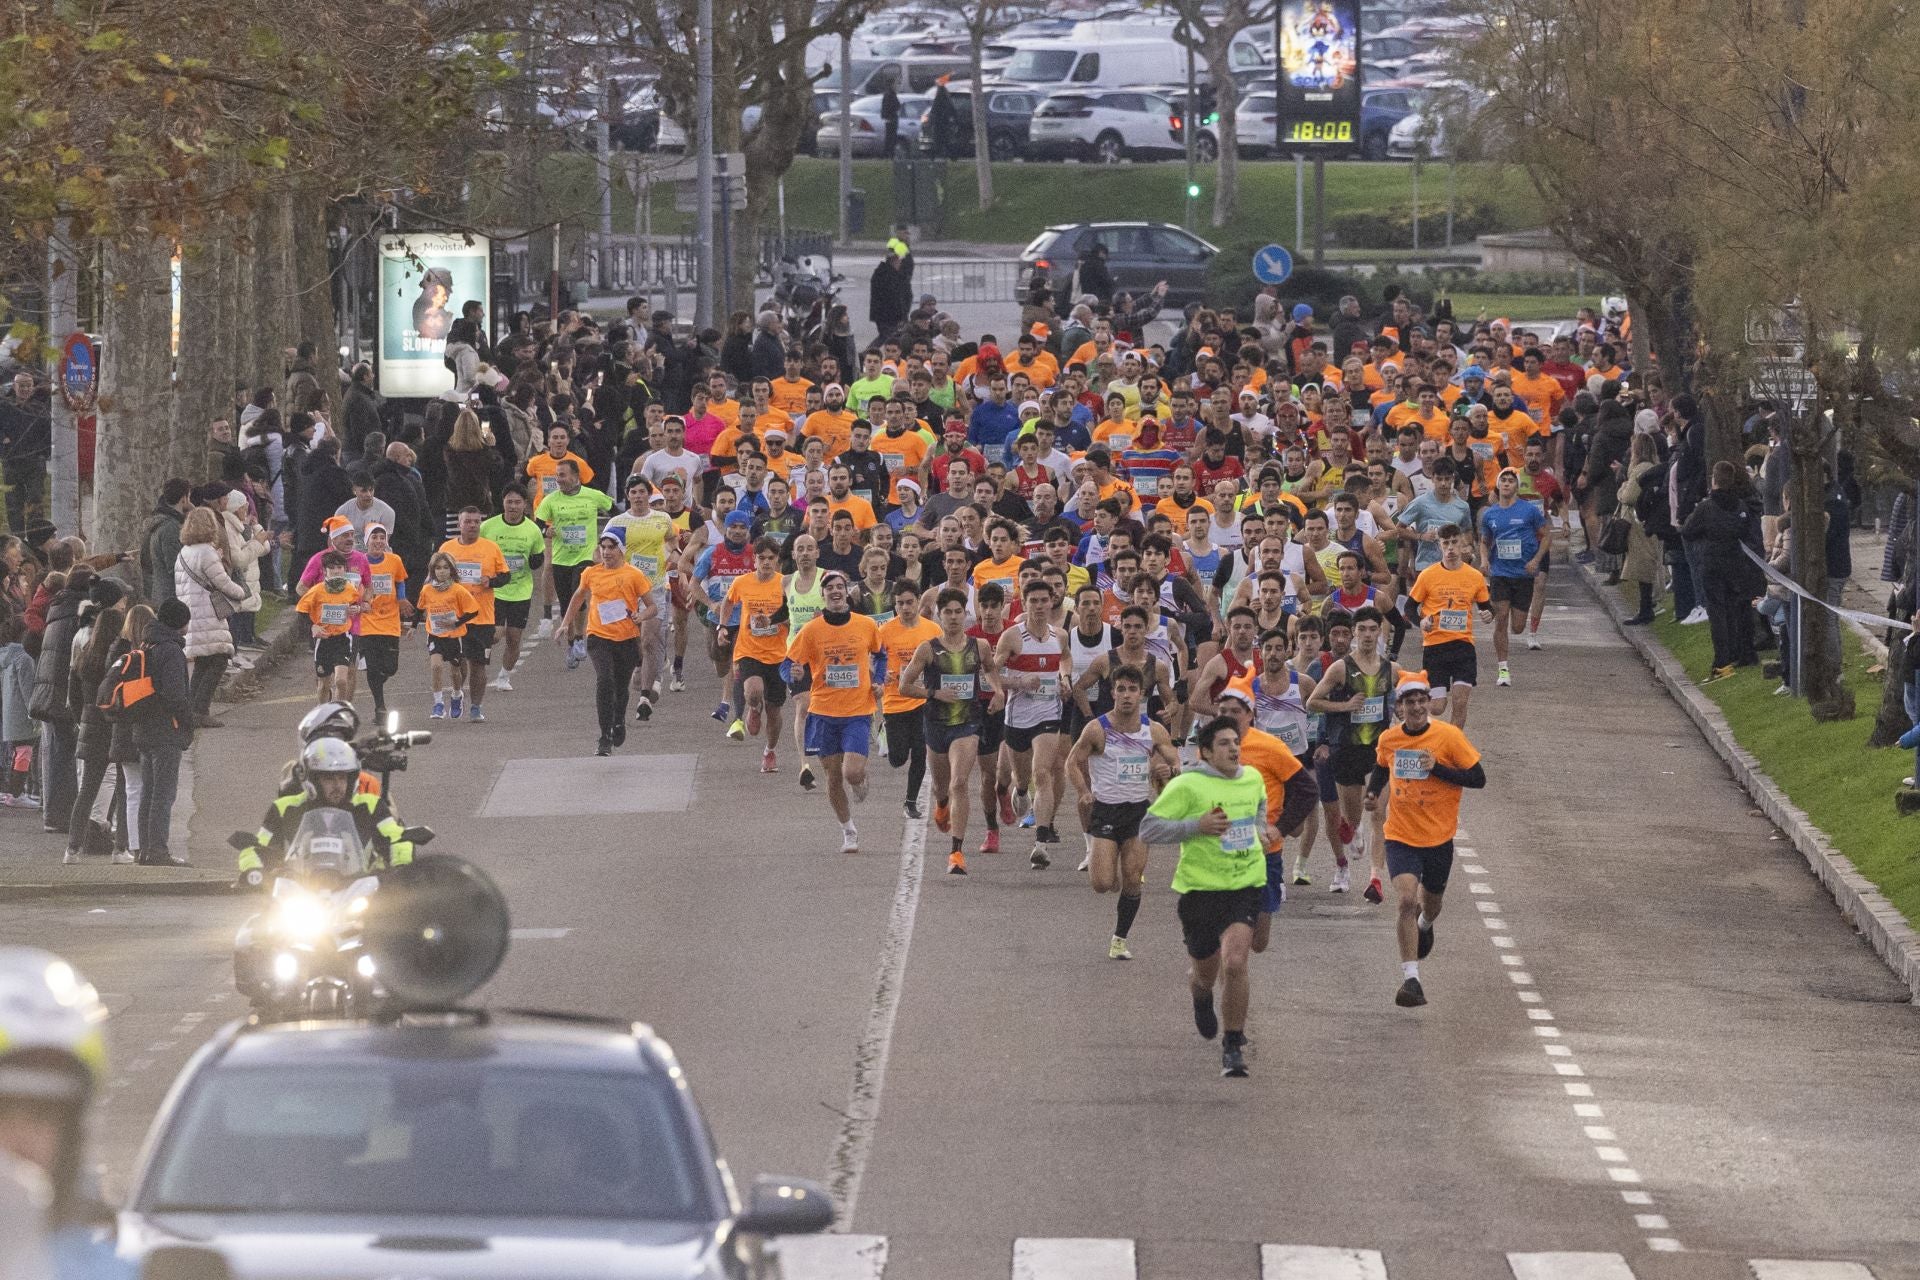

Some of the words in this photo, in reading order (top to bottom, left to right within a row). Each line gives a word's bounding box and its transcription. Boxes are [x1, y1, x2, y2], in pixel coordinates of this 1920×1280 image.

[1293, 121, 1351, 140] 18:00
[564, 531, 580, 539] 732
[634, 560, 651, 571] 452
[1441, 615, 1463, 625] 4273
[827, 671, 853, 681] 4946
[1122, 764, 1142, 774] 215
[1396, 758, 1422, 770] 4890
